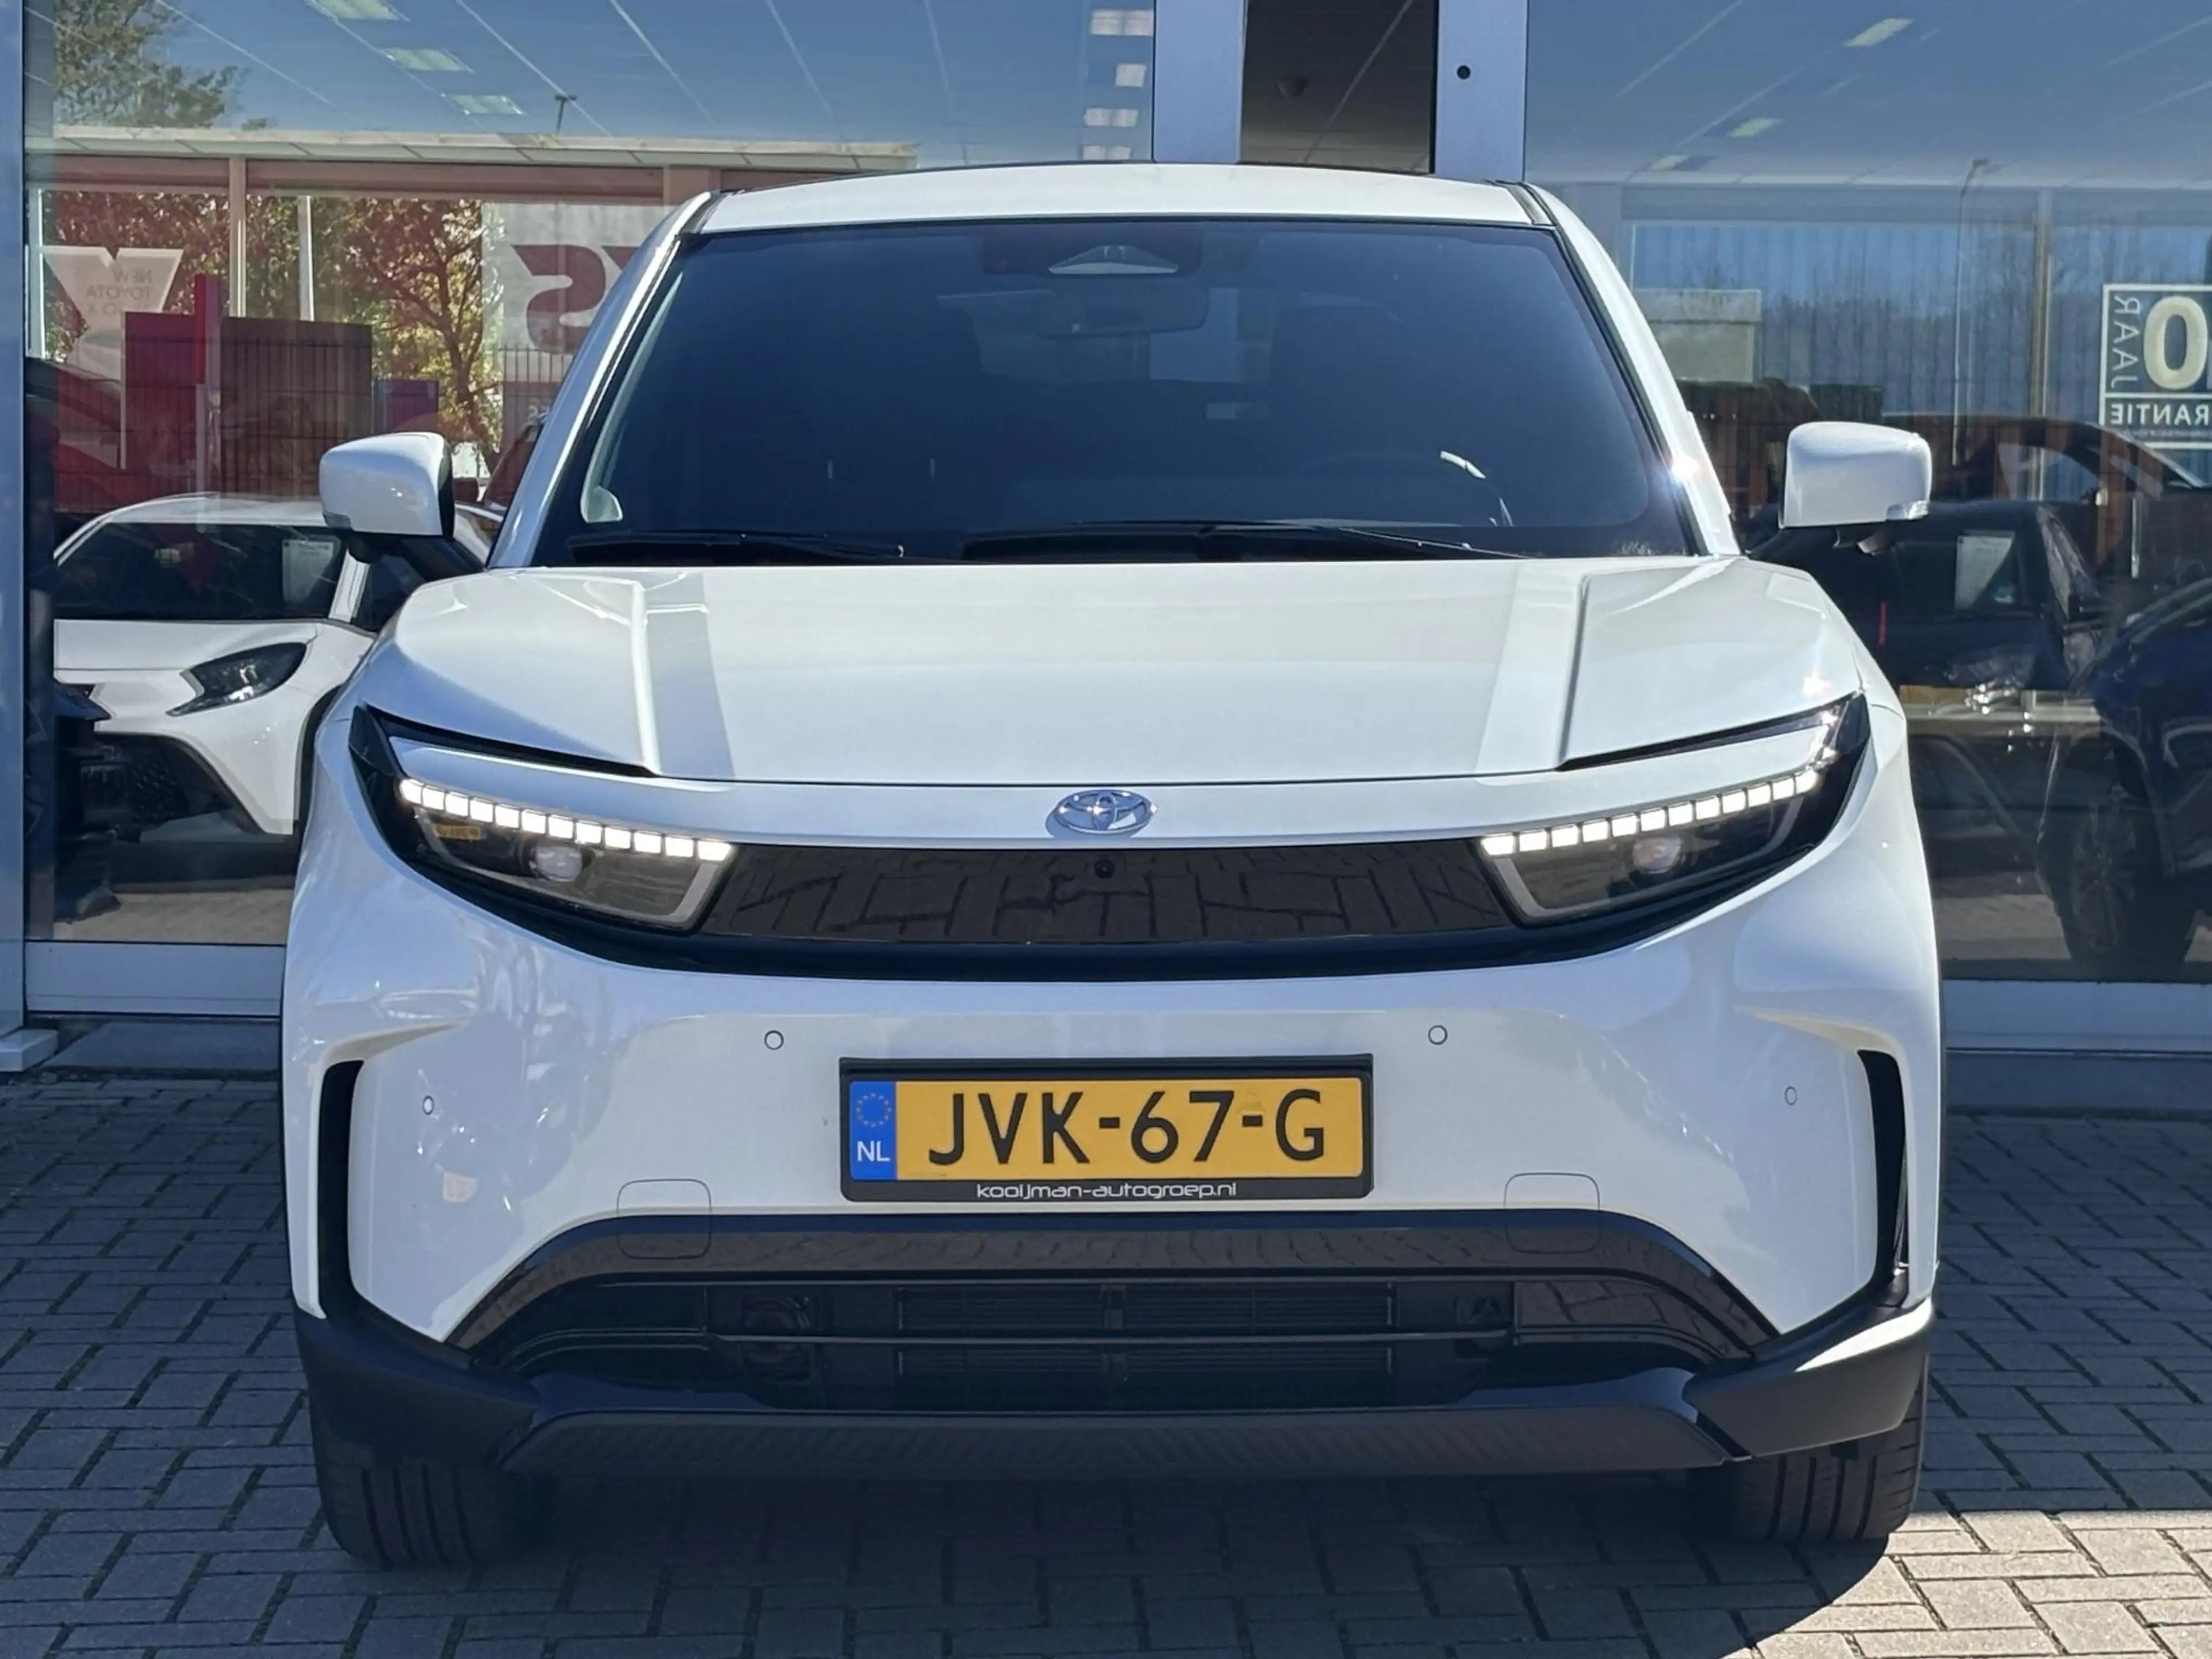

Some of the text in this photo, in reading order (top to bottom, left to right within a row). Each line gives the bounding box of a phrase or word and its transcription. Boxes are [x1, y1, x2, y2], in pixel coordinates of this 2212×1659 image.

[929, 1088, 1324, 1165] JVK-67-G
[857, 1141, 890, 1162] NL
[976, 1182, 1237, 1199] kooijman-autogroep.nl
